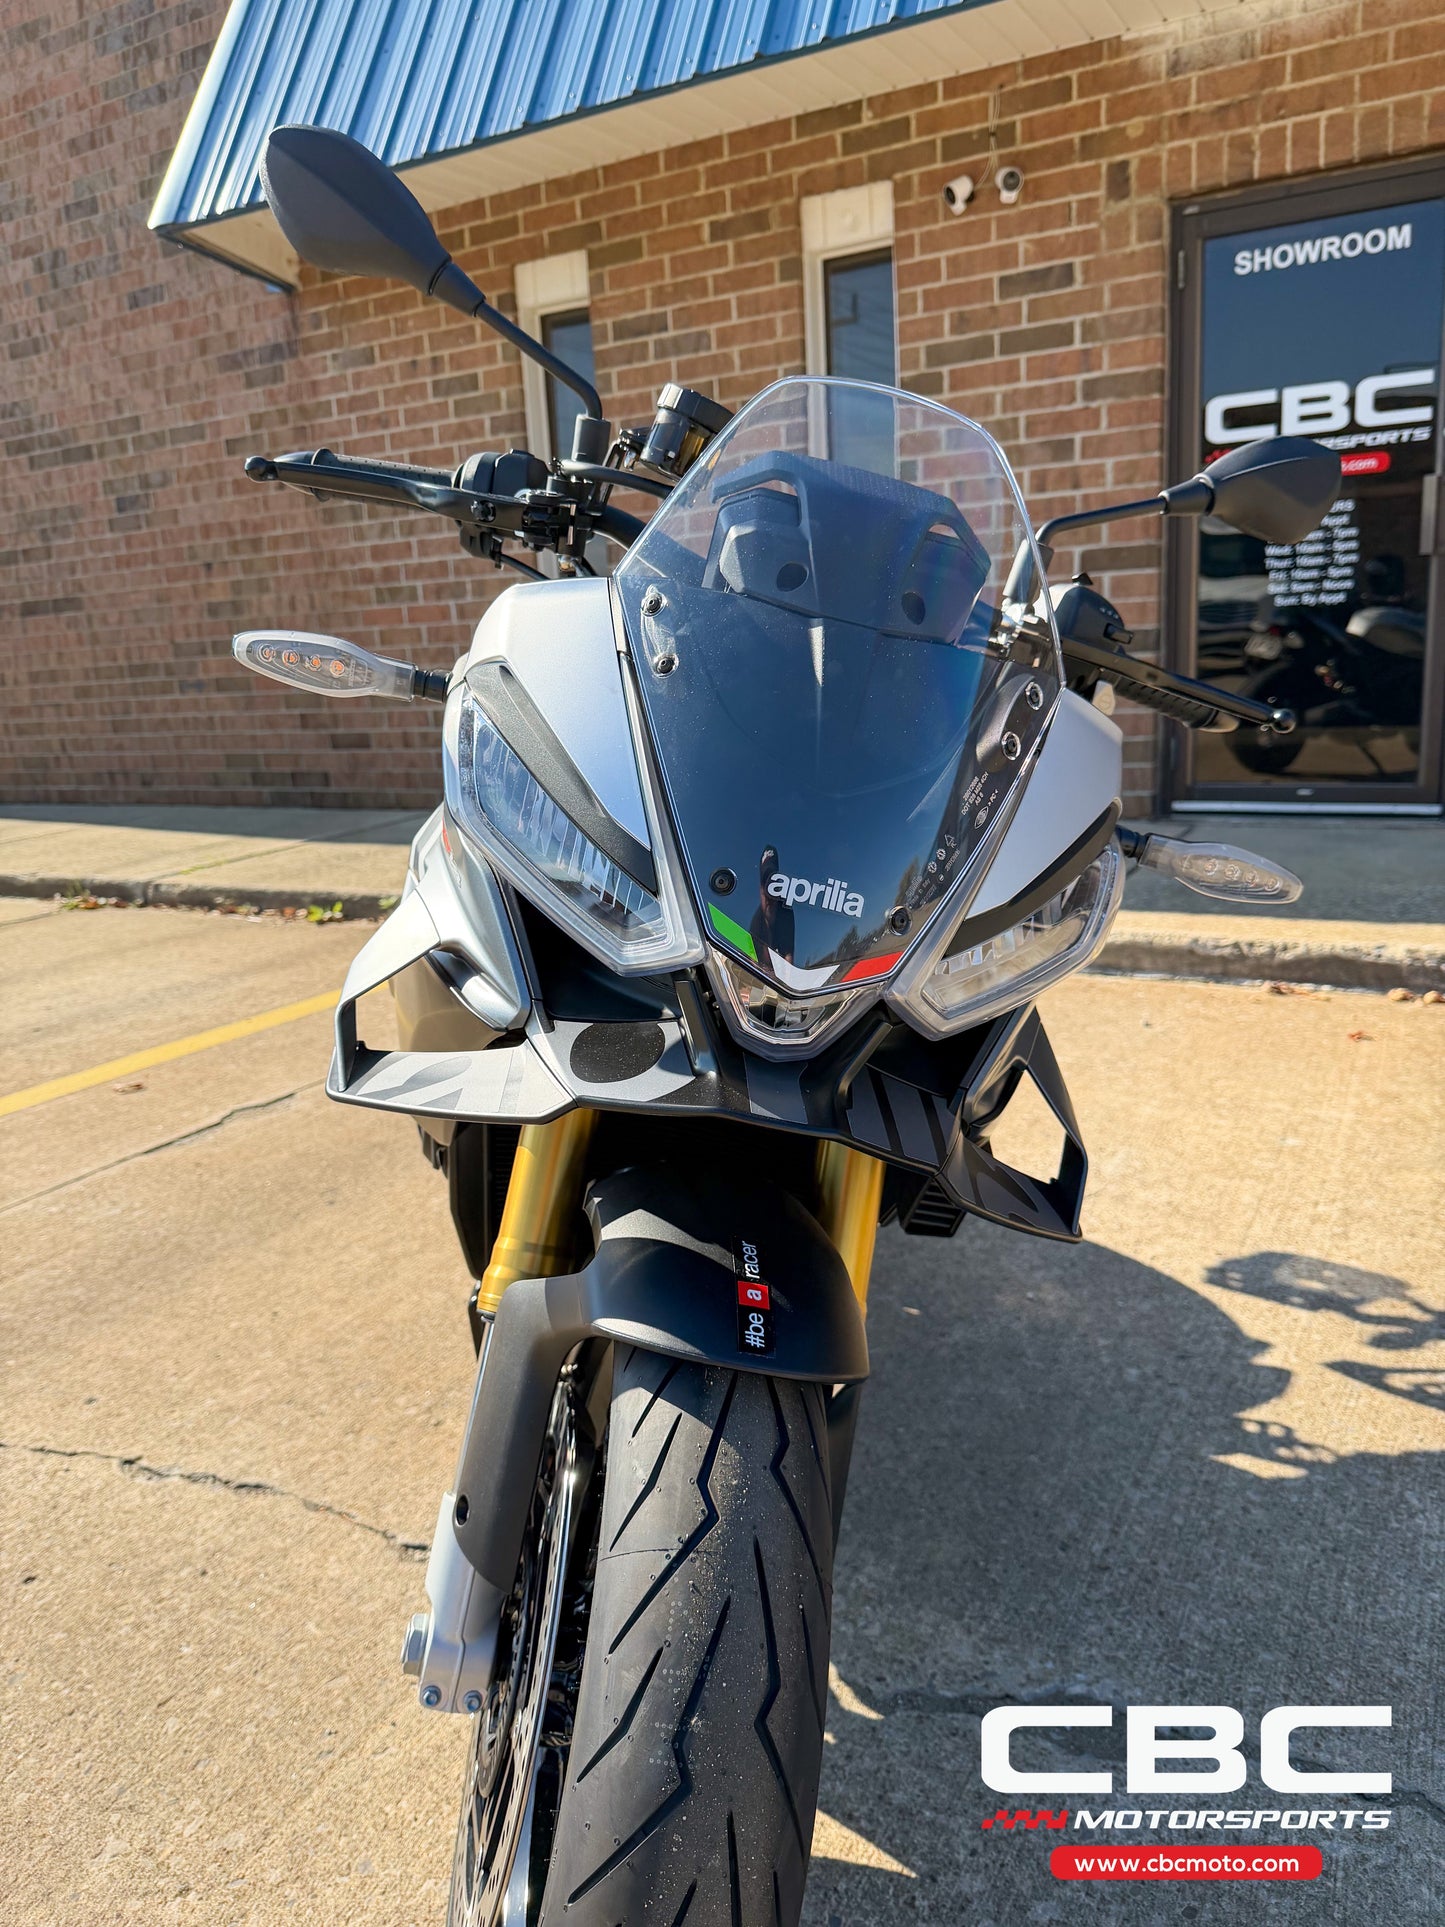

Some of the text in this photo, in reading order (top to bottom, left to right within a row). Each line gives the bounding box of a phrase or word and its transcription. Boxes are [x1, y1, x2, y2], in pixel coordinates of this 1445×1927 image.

[1234, 224, 1412, 275] SHOWROOM
[1205, 369, 1435, 444] CBC
[767, 873, 865, 918] aprilia
[741, 1240, 765, 1348] #be a racer
